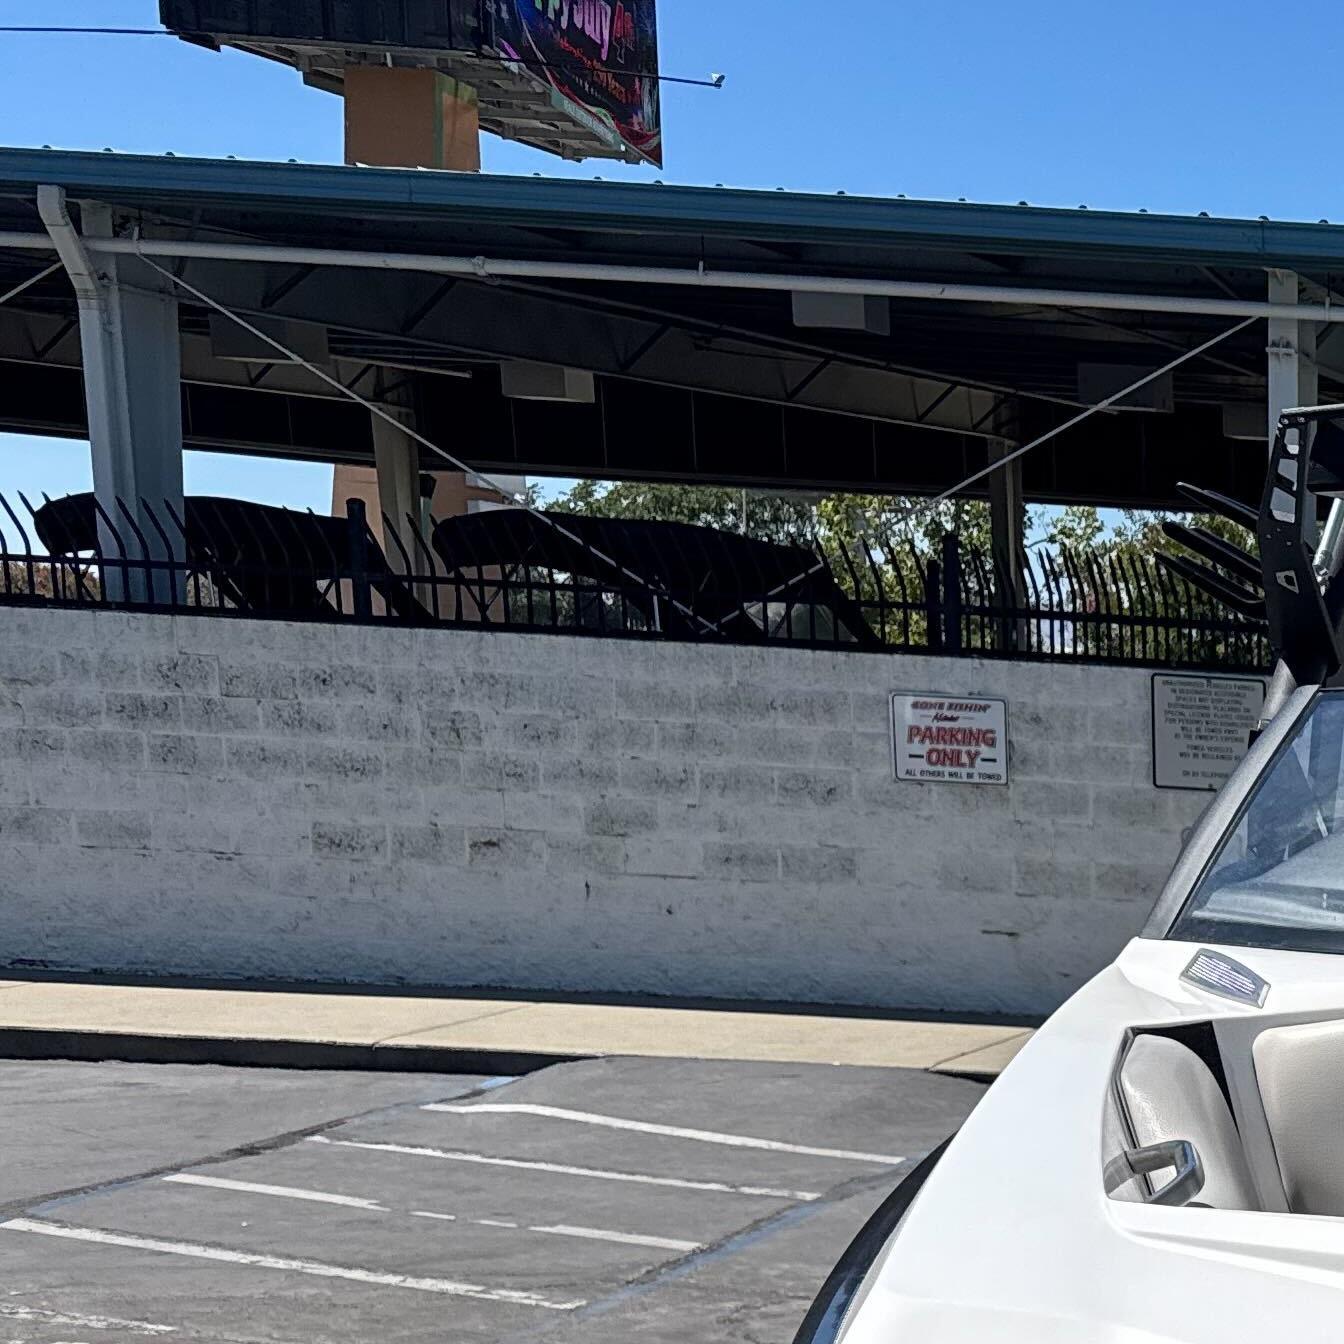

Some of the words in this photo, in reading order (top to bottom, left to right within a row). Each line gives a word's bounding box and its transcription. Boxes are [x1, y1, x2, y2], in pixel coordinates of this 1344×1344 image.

[907, 725, 997, 748] PARKING
[926, 747, 981, 768] ONLY
[905, 768, 917, 777] ALL
[948, 771, 963, 779] WILL
